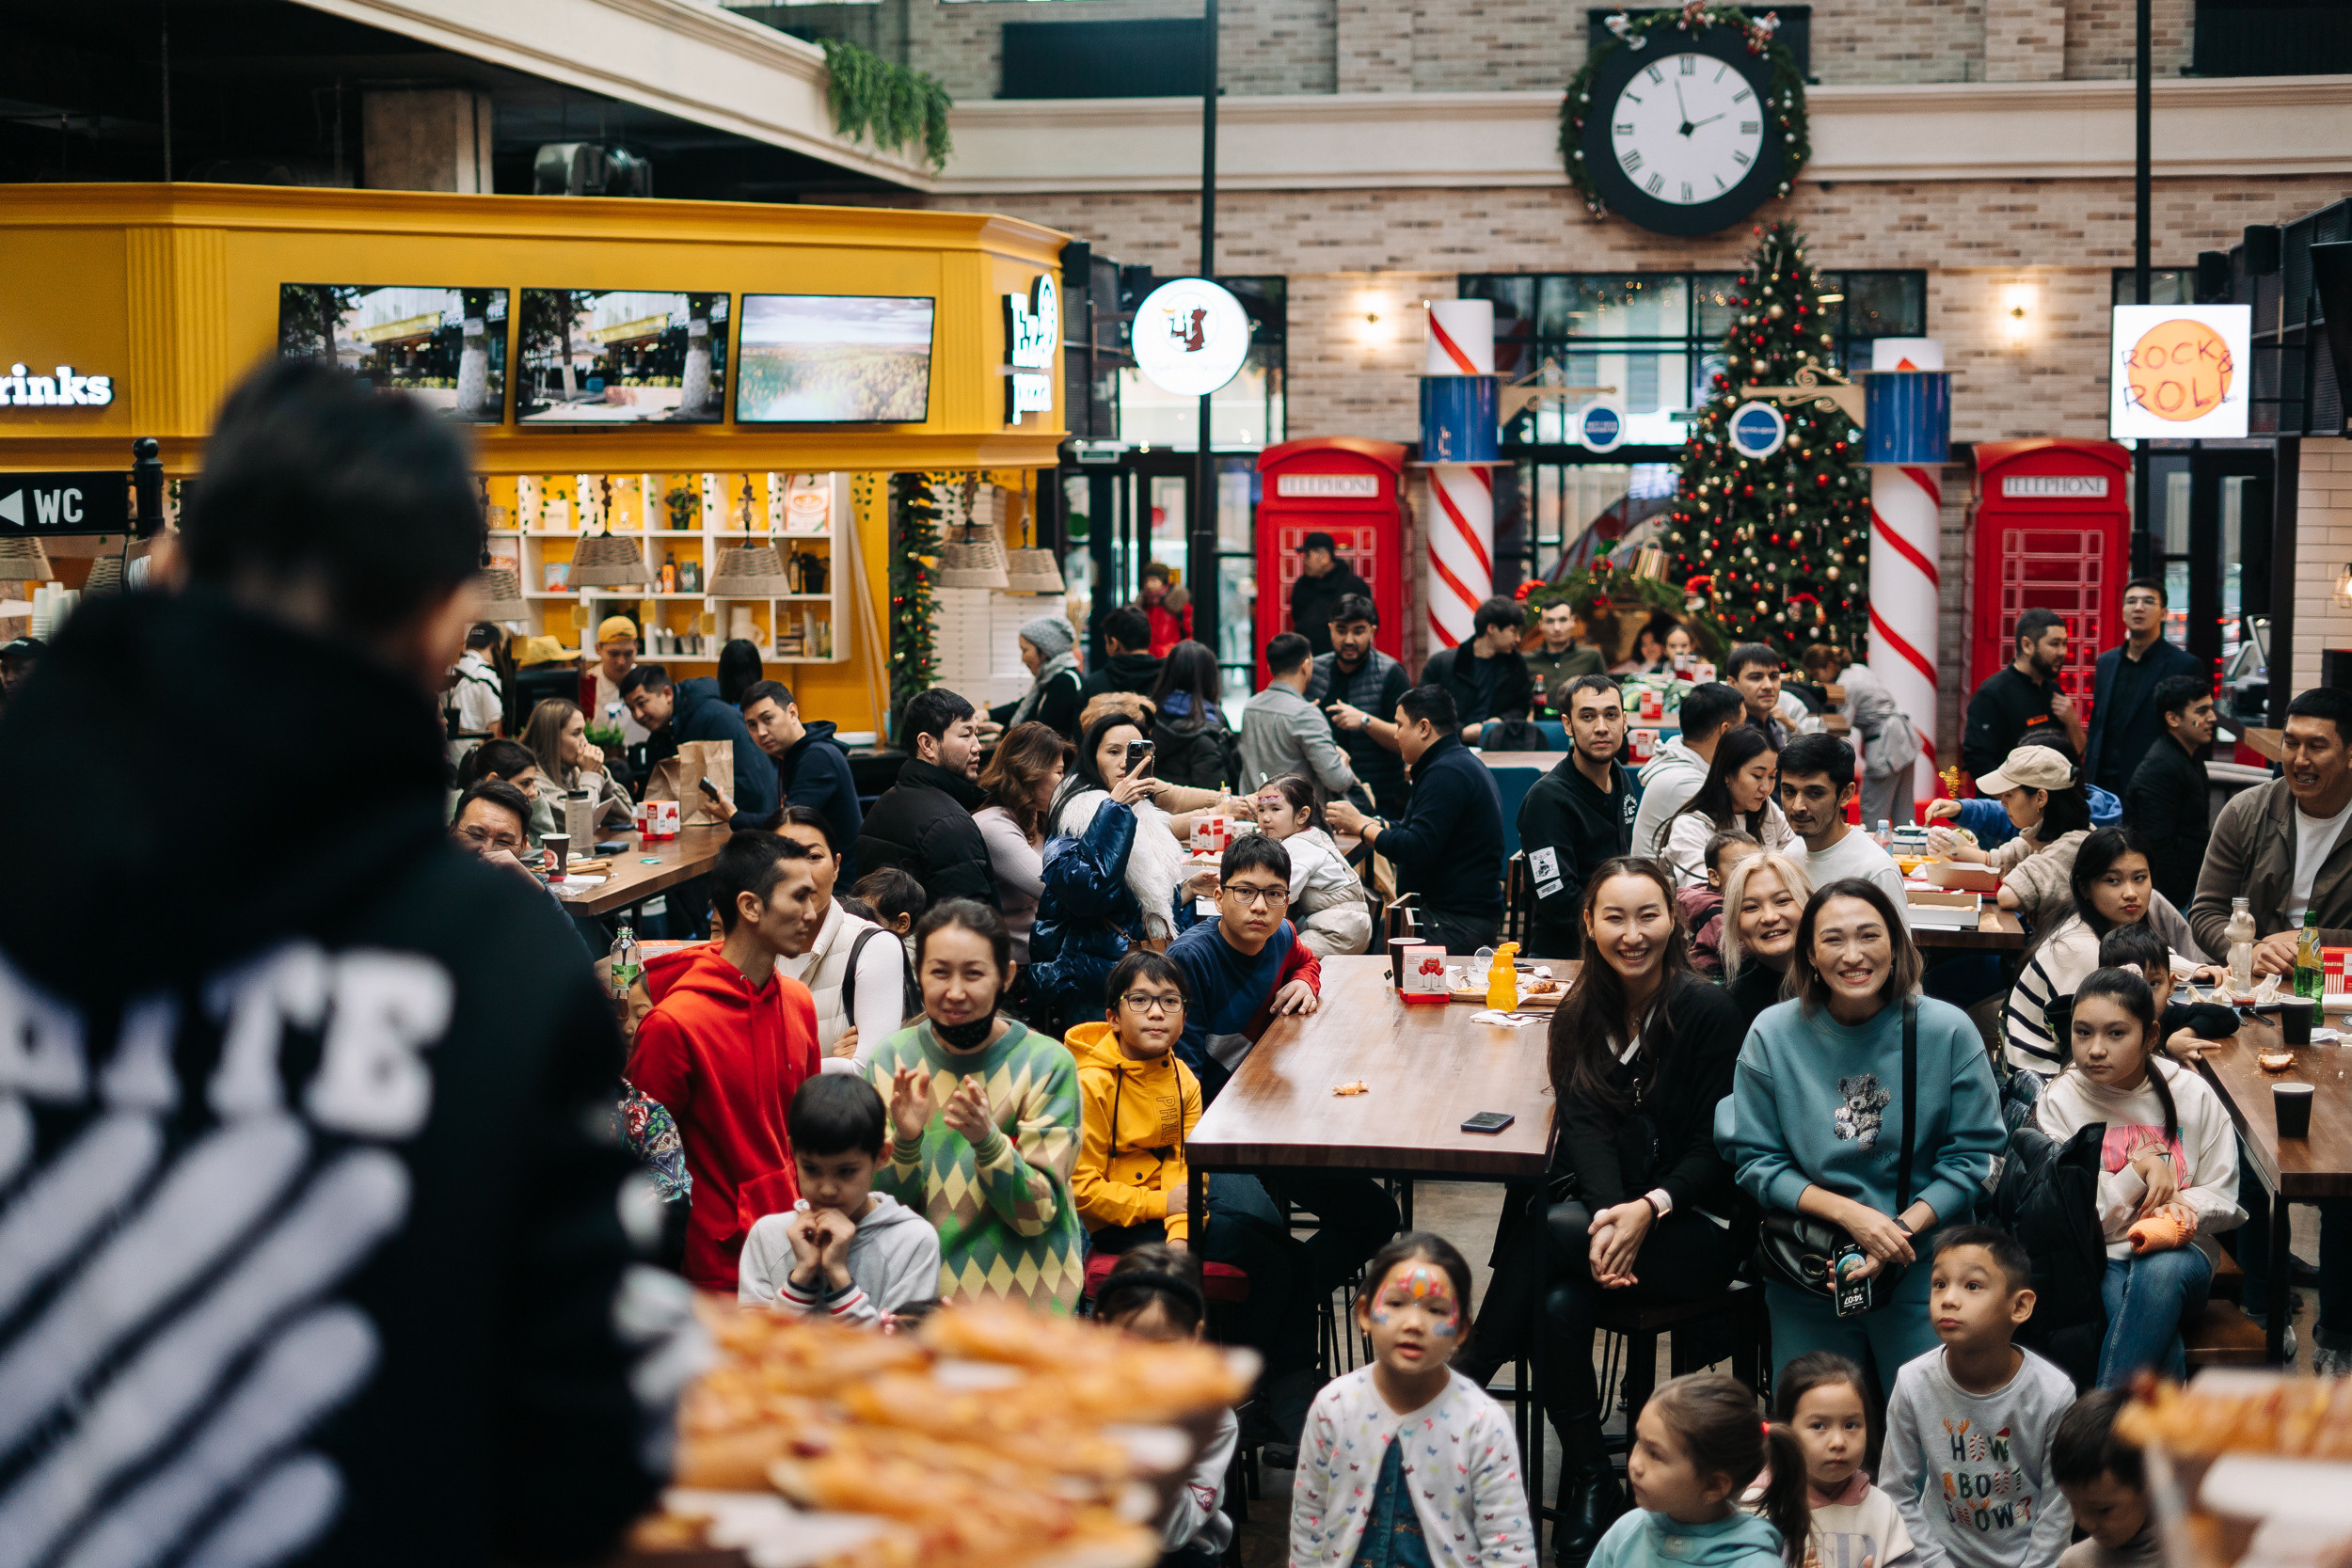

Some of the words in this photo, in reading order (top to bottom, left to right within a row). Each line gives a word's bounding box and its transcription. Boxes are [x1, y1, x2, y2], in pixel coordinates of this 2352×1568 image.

[0, 363, 114, 406] rinks
[2123, 374, 2237, 414] ROLL
[2006, 476, 2103, 494] TELEPHONE
[33, 488, 84, 524] WC
[1843, 1293, 1864, 1307] 14:07
[1946, 1428, 2010, 1463] HOW
